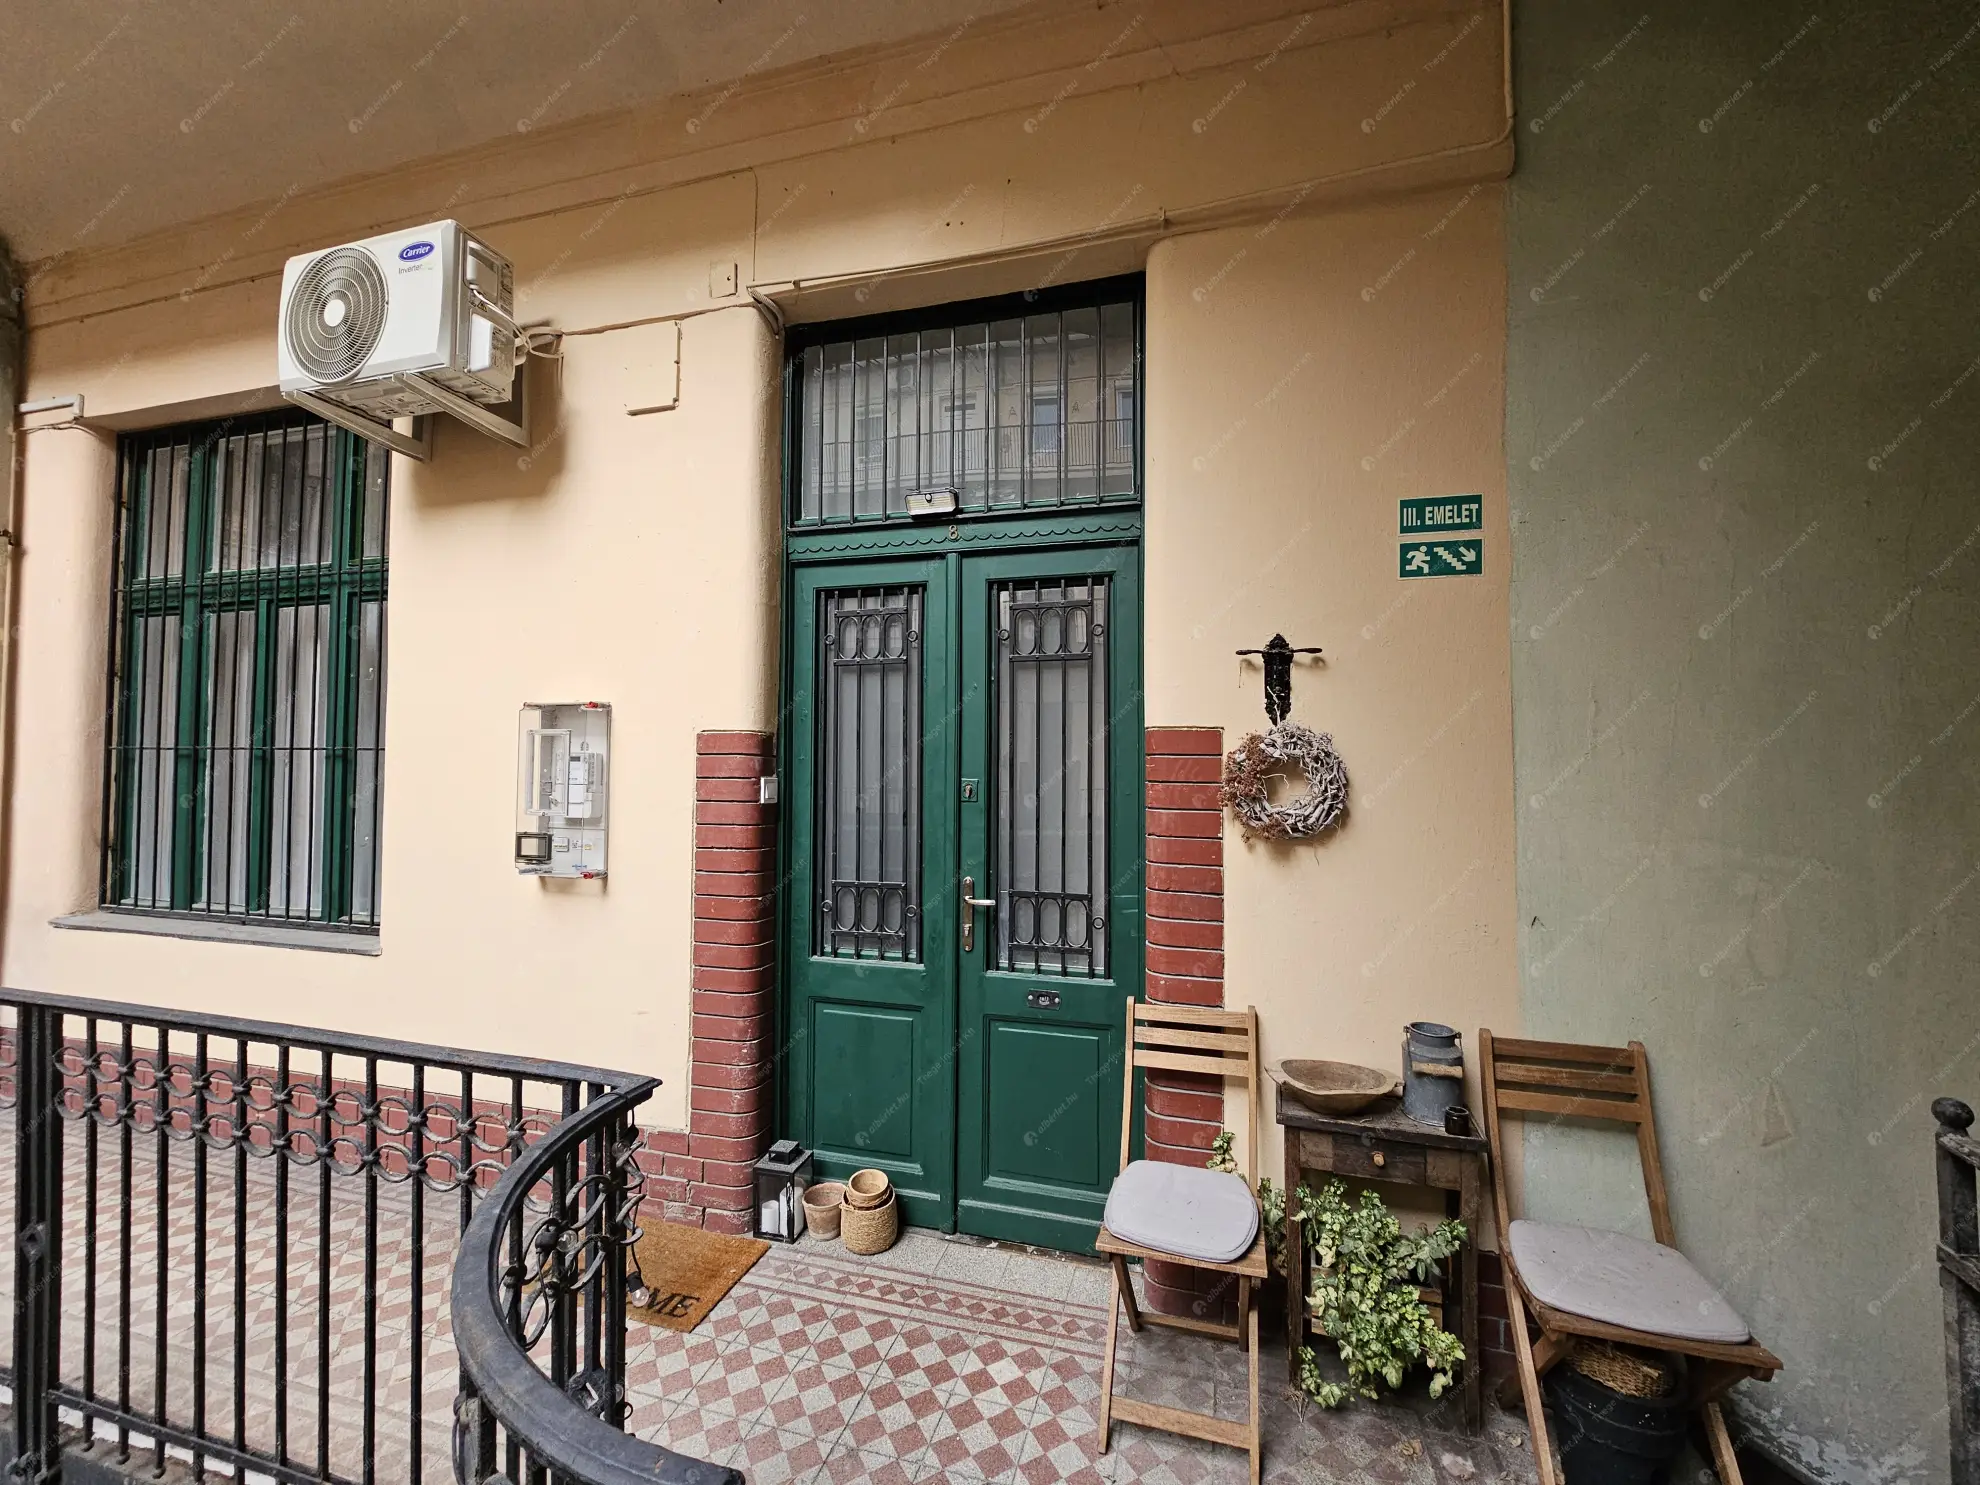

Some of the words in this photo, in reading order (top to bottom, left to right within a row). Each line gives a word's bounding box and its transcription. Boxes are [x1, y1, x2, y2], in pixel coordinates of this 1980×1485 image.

[403, 244, 431, 258] Carrier
[398, 263, 423, 274] Inverter
[1403, 507, 1421, 527] III.
[1425, 503, 1479, 526] EMELET
[949, 524, 958, 540] 8
